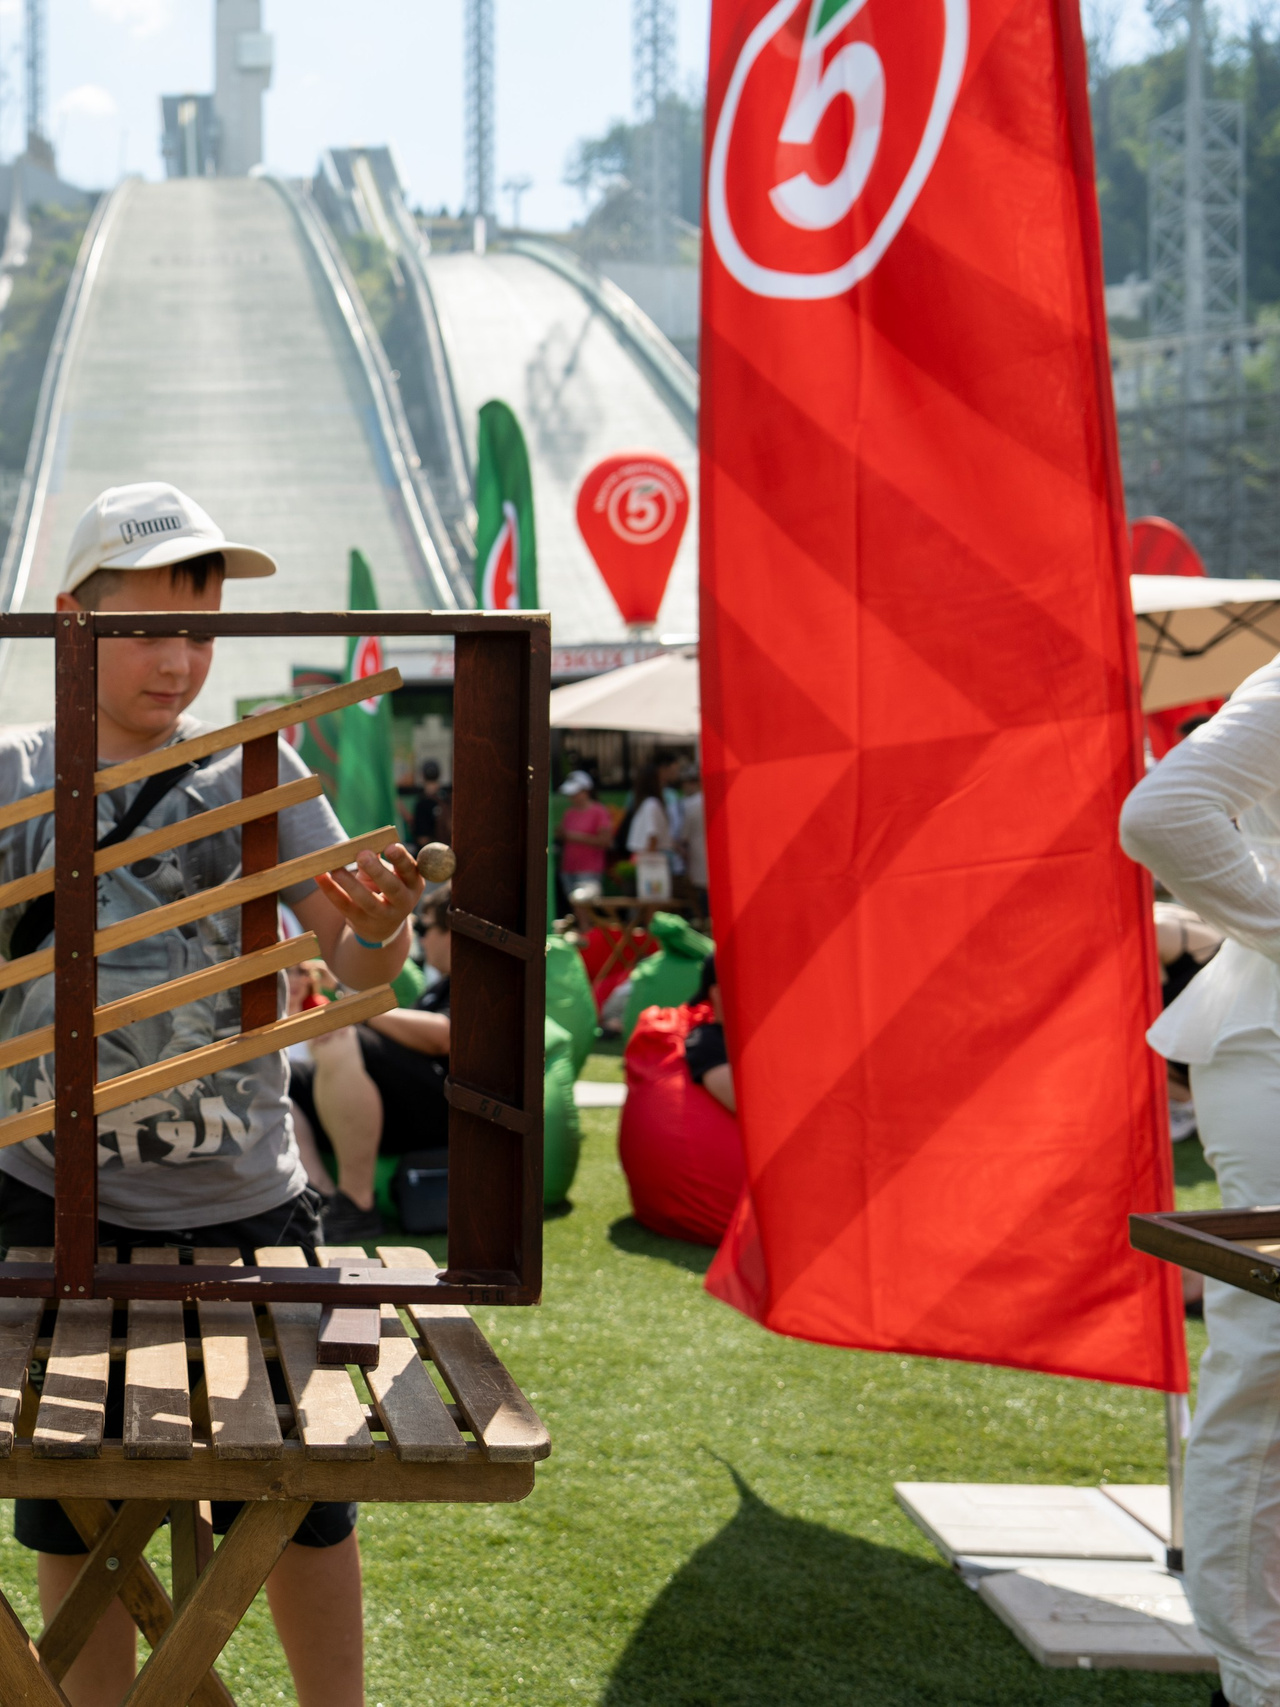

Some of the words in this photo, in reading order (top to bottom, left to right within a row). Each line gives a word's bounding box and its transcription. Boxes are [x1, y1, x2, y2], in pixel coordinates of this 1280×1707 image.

[768, 0, 886, 231] 5
[625, 481, 660, 532] 5
[480, 1098, 503, 1118] 50
[467, 1288, 505, 1303] 150
